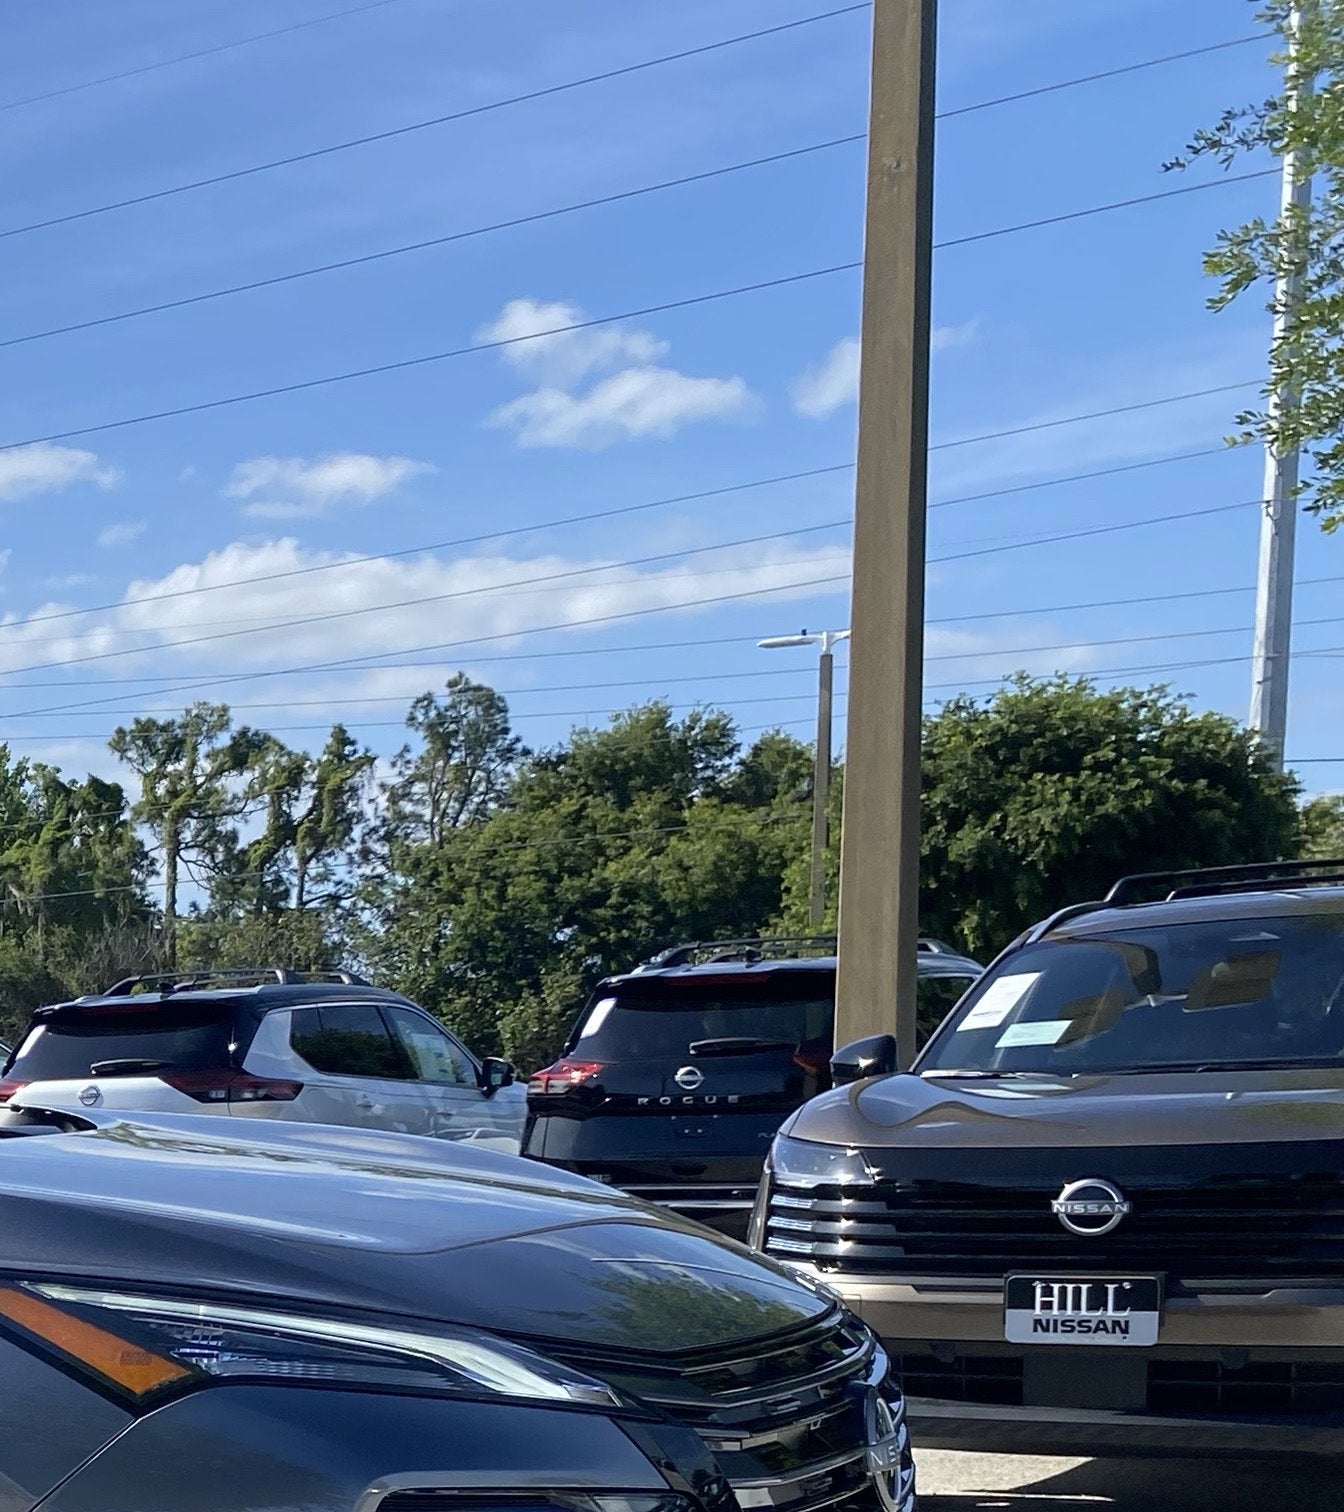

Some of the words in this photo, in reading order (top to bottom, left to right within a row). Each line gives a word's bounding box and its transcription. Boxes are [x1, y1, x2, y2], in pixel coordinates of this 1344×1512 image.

[637, 1095, 739, 1105] ROGUE
[1052, 1202, 1130, 1214] NISSAN
[1032, 1282, 1131, 1317] HILL
[1032, 1318, 1130, 1335] NISSAN
